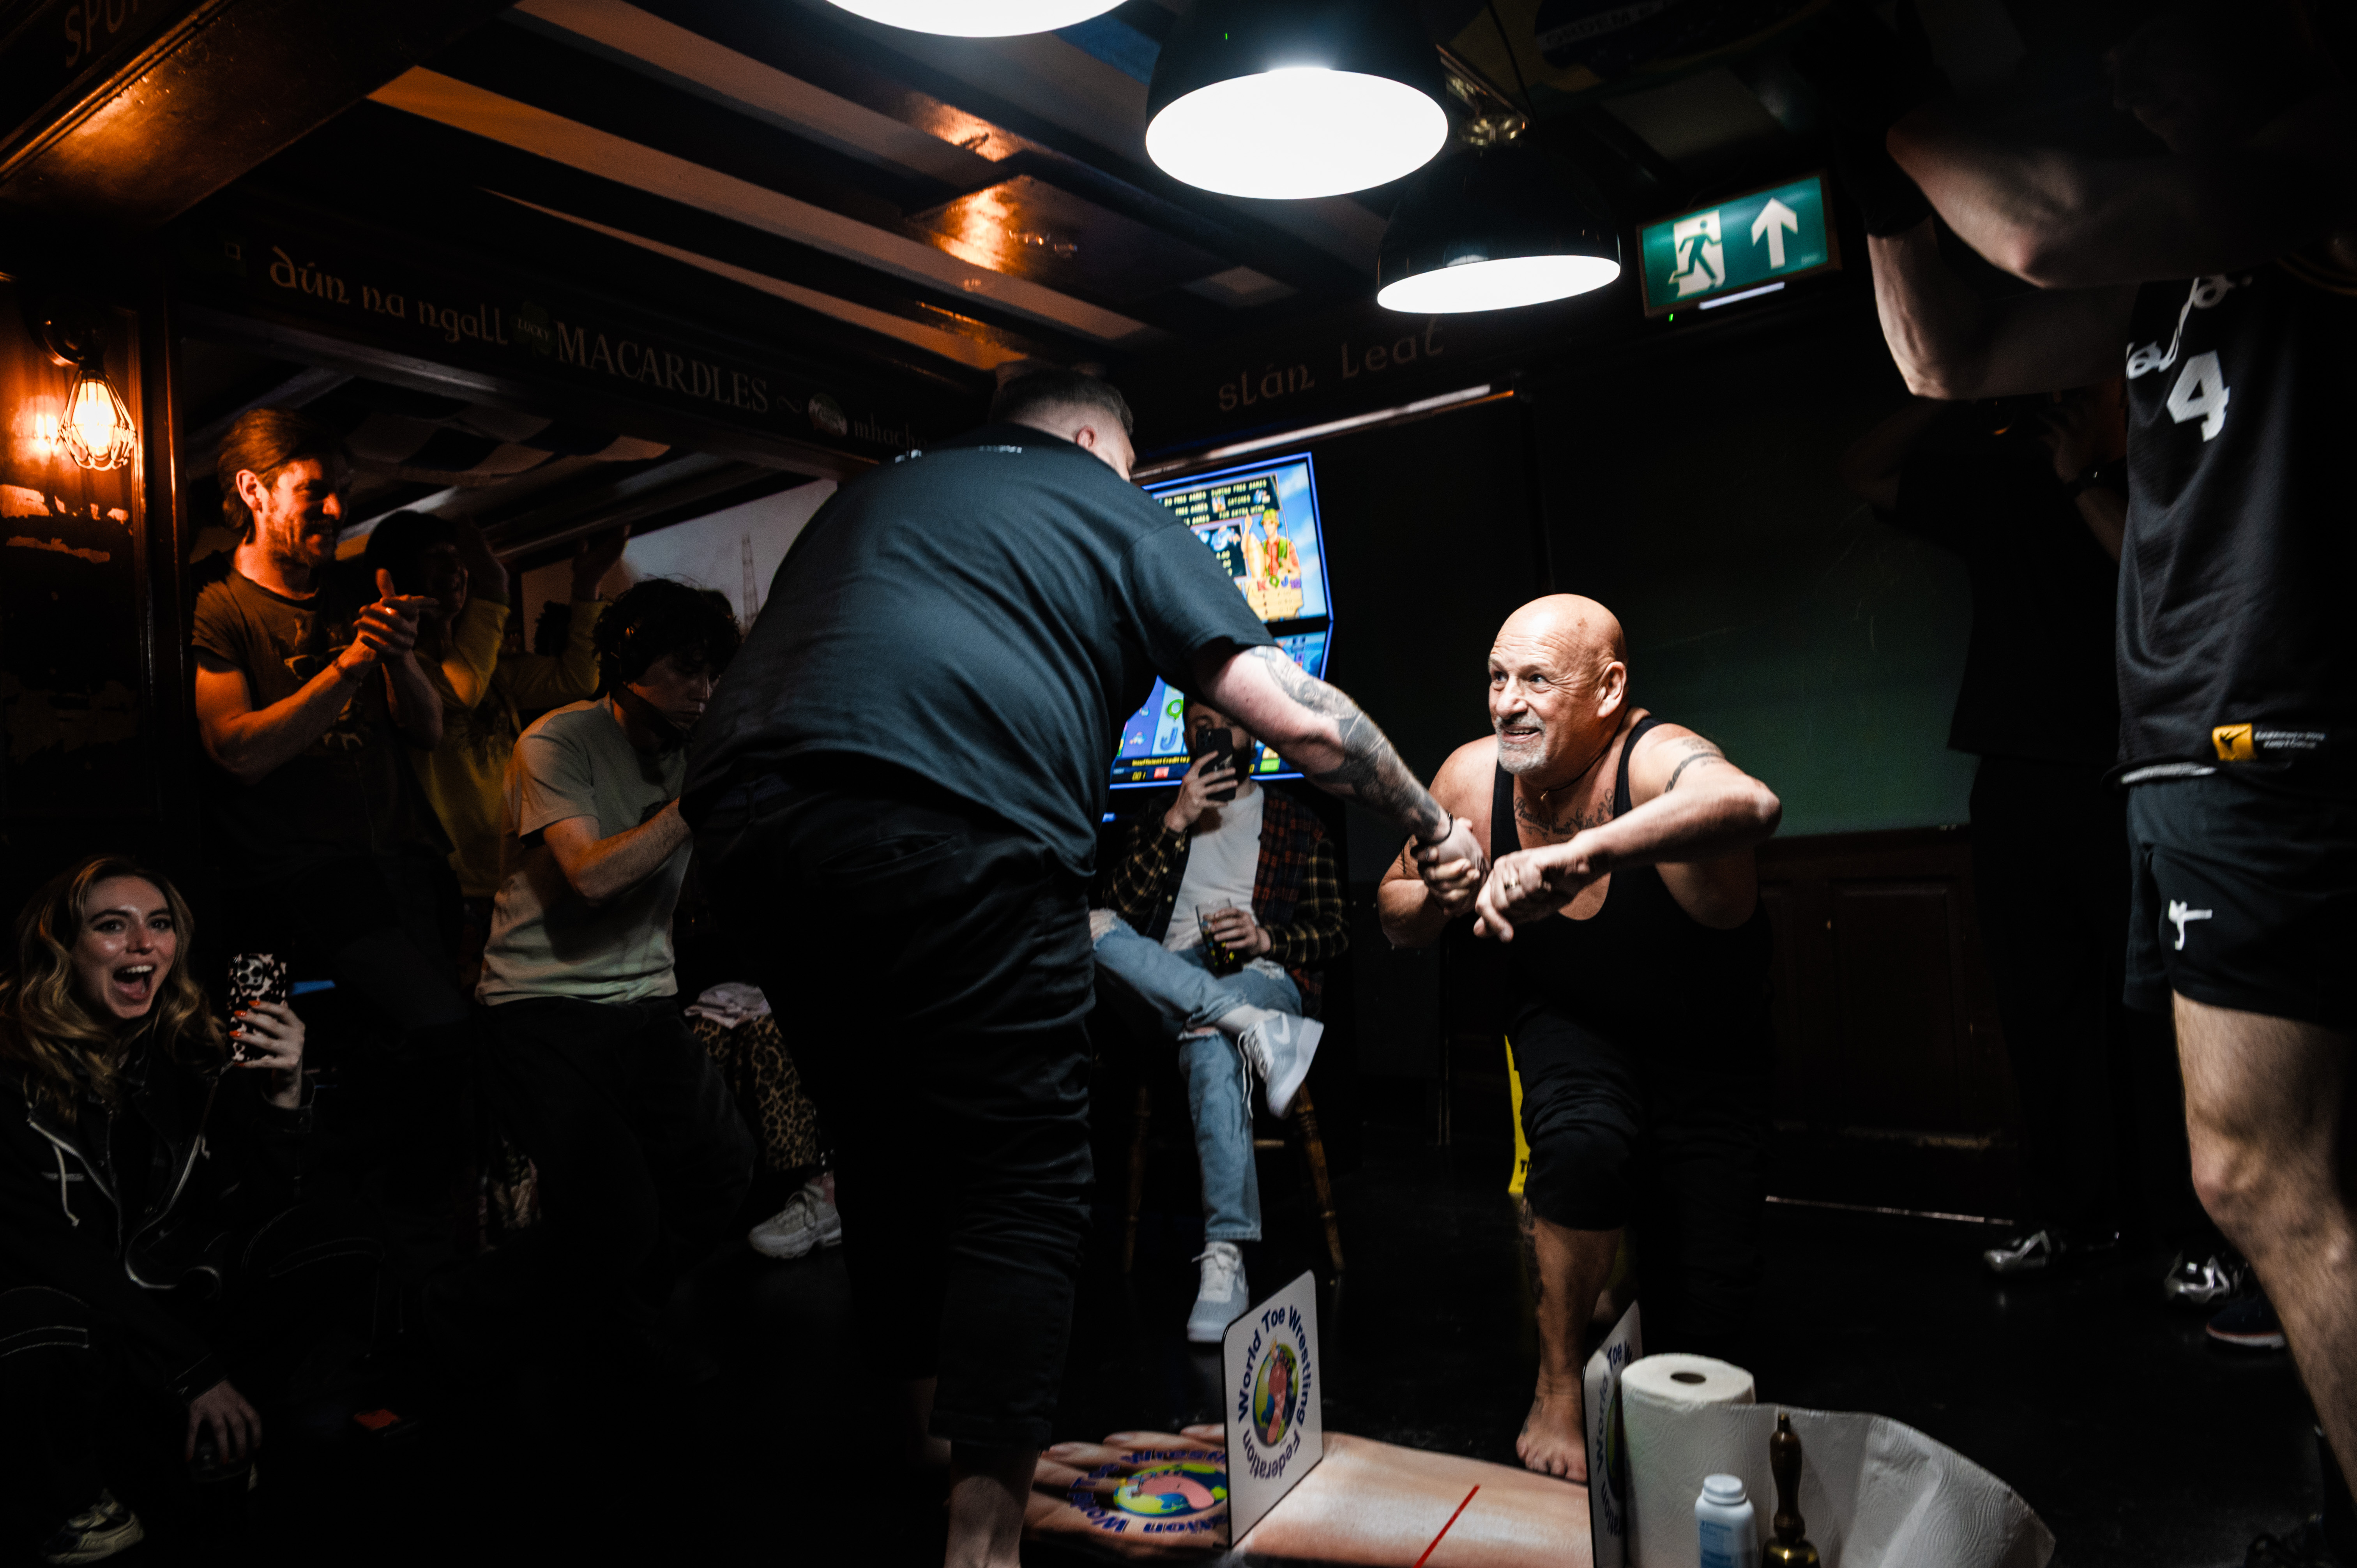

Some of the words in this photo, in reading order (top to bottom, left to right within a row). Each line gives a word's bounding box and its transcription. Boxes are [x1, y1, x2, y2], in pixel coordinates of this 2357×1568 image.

[362, 283, 406, 320] na
[418, 303, 509, 345] ngall
[518, 318, 550, 342] LUCKY
[553, 320, 769, 415] MACARDLES
[2166, 349, 2230, 443] 4
[1174, 494, 1187, 505] FREE
[1189, 491, 1206, 502] GAMES
[1211, 486, 1231, 497] DURING
[1233, 483, 1246, 493] FREE
[1249, 479, 1267, 490] GAMES
[1175, 506, 1188, 516] FREE
[1191, 502, 1208, 514] GAMES
[1193, 514, 1210, 525] GAMES
[1270, 576, 1280, 588] Q
[1281, 576, 1288, 587] J
[1161, 727, 1178, 751] J
[1132, 758, 1162, 767] Insufficient
[1163, 756, 1180, 765] Credit
[1262, 1307, 1285, 1334] Toe
[1239, 1327, 1262, 1424] World
[1288, 1304, 1311, 1427] Wrestling
[1597, 1374, 1608, 1475] World
[1608, 1342, 1622, 1371] Toe
[1243, 1428, 1300, 1480] Federation
